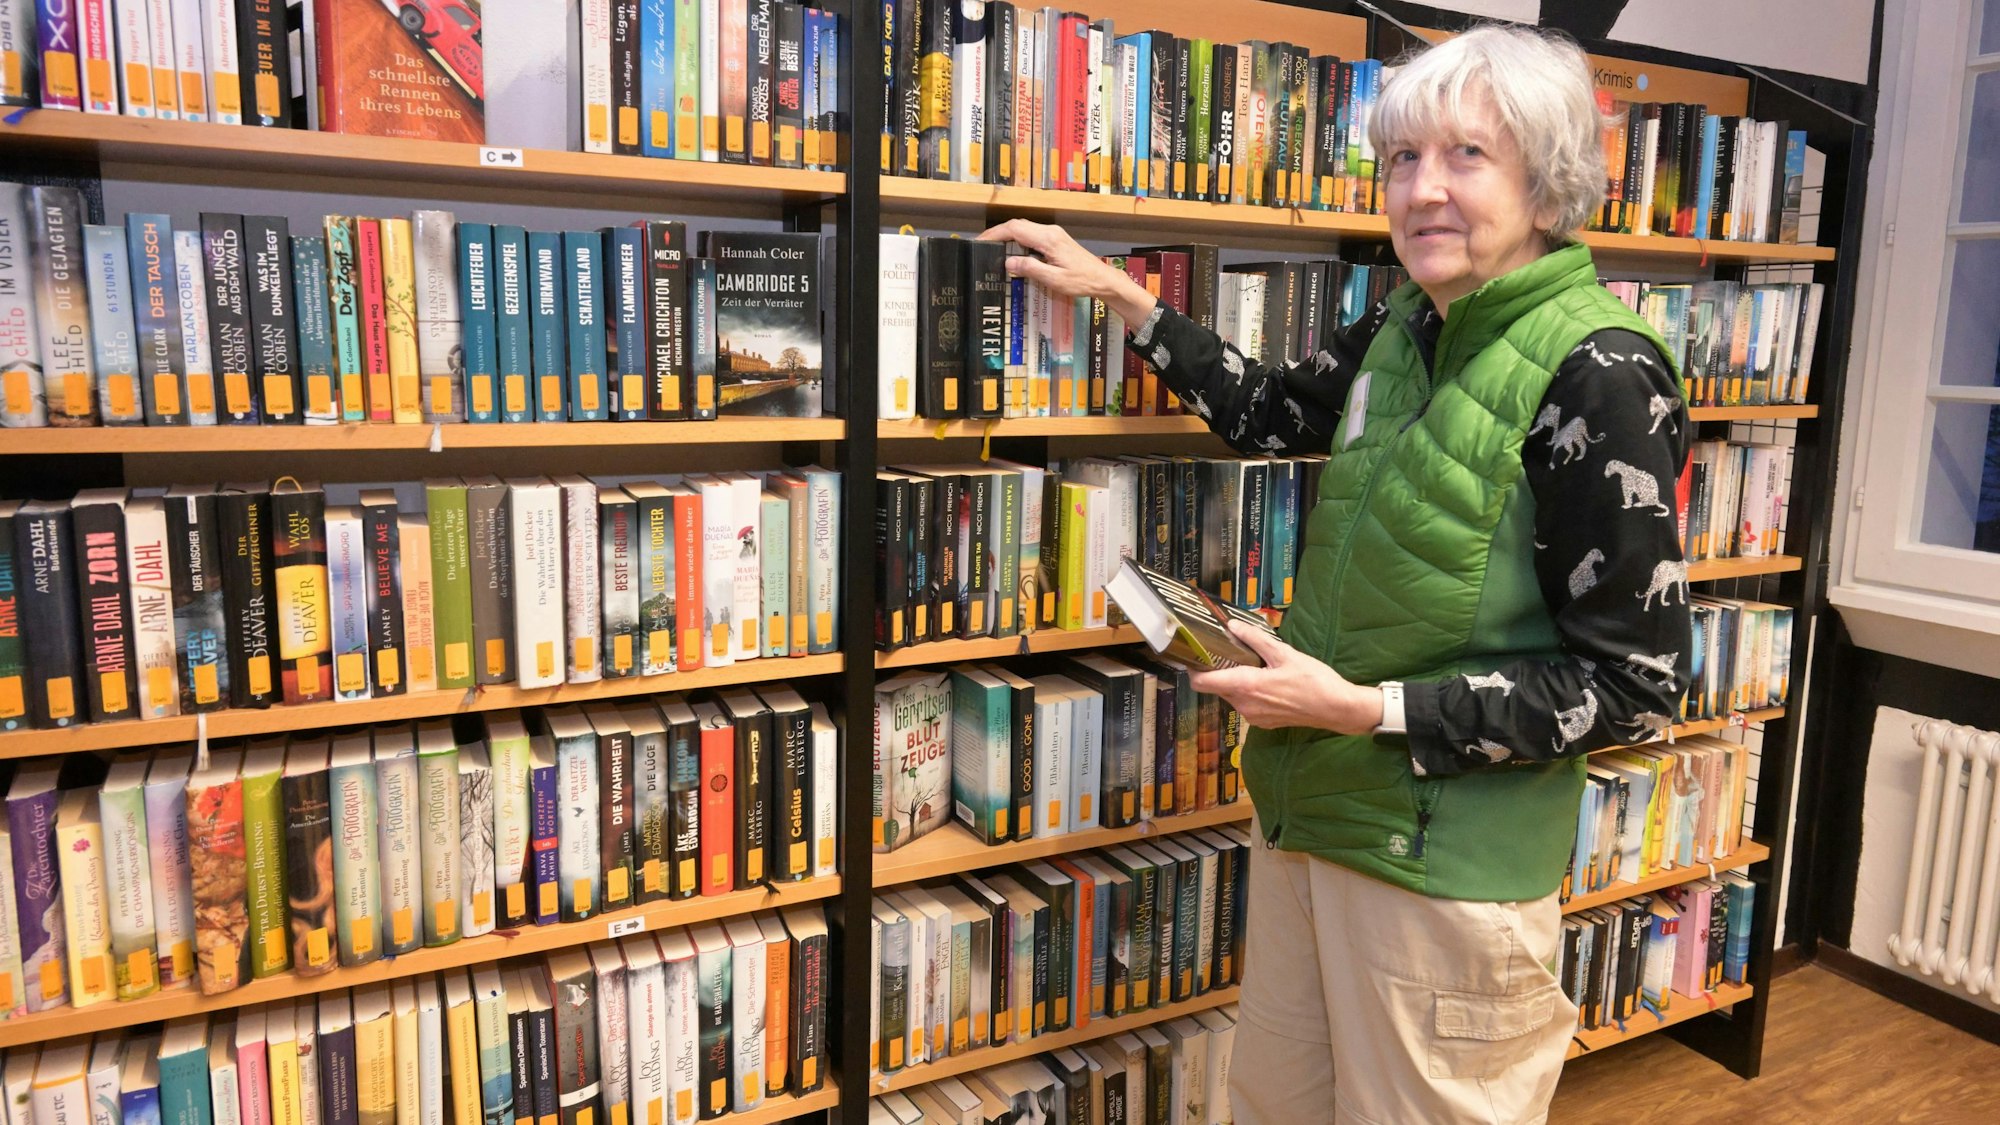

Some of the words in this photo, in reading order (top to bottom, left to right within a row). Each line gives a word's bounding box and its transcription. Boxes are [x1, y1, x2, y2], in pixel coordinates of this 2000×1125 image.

[615, 2, 625, 42] Lügen.
[885, 4, 893, 41] KIND
[1004, 10, 1010, 25] 23
[395, 54, 424, 68] Das
[787, 41, 798, 71] BESTIE
[1180, 49, 1188, 87] Schinder
[1239, 55, 1249, 87] Hand
[369, 68, 450, 87] schnellste
[381, 84, 440, 102] Rennen
[779, 82, 788, 106] CHRIS
[788, 78, 799, 110] CARTER
[1200, 65, 1210, 117] Herzschuss
[1223, 57, 1232, 107] EISENBERG
[1594, 68, 1633, 89] Krimis
[360, 98, 401, 114] ihres
[406, 103, 462, 119] Lebens
[1092, 104, 1100, 139] FITZEK
[1178, 92, 1186, 122] Unterm
[1239, 93, 1248, 119] Tote
[1220, 110, 1233, 165] FÖHR
[486, 152, 496, 162] C
[47, 206, 68, 280] GEJAGTEN
[144, 223, 162, 279] TAUSCH
[212, 238, 225, 282] JUNGE
[224, 229, 238, 266] WALD
[257, 253, 267, 261] IM
[266, 229, 277, 259] LIEGT
[655, 250, 680, 261] MICRO
[721, 247, 767, 259] Hannah
[771, 248, 804, 259] Coler
[103, 253, 116, 300] STUNDEN
[229, 268, 239, 293] DEM
[259, 262, 269, 292] WAS
[335, 250, 349, 285] Zopf
[469, 242, 486, 311] LEUCHTFEUER
[503, 243, 519, 315] GEZEITENSPIEL
[539, 249, 554, 315] STURMWAND
[621, 244, 635, 324] FLAMMENMEER
[717, 274, 795, 292] CAMBRIDGE
[801, 278, 809, 292] 5
[883, 270, 916, 280] FOLLETT
[58, 289, 72, 309] DIE
[148, 286, 165, 318] DER
[179, 264, 193, 309] COBEN
[217, 286, 227, 307] DER
[269, 259, 282, 317] DUNKELN
[339, 289, 352, 315] Der
[576, 247, 593, 325] SCHATTENLAND
[722, 298, 741, 307] Zeit
[745, 298, 760, 307] der
[764, 298, 804, 308] Verräter
[1287, 271, 1295, 307] FRENCH
[108, 304, 118, 313] 61
[231, 296, 242, 315] AUS
[655, 278, 670, 333] CRICHTON
[674, 307, 682, 334] PRESTON
[883, 318, 916, 327] FREIHEIT
[885, 301, 915, 310] KINDER
[1286, 308, 1295, 326] TANA
[181, 314, 198, 363] HARLAN
[346, 327, 354, 359] Colombani
[697, 317, 705, 354] DEBORAH
[982, 306, 1001, 357] NEVER
[261, 324, 275, 375] HARLAN
[274, 328, 287, 373] COBEN
[1254, 474, 1262, 535] GALBRAITH
[30, 520, 48, 558] DAHL
[289, 510, 299, 548] WAHL
[300, 517, 310, 540] LOS
[377, 523, 389, 543] ME
[477, 508, 485, 538] Dicker
[650, 508, 664, 552] TOCHTER
[51, 519, 60, 571] Bußestunde
[85, 532, 118, 585] ZORN
[189, 530, 200, 573] TÄUSCHER
[238, 535, 248, 556] DER
[248, 504, 262, 586] GIFTZEICHNER
[477, 540, 487, 559] Joel
[488, 508, 498, 575] Verschwinden
[36, 560, 49, 593] ARNE
[134, 540, 164, 583] DAHL
[377, 548, 390, 597] BELIEVE
[499, 541, 508, 585] Stephanie
[651, 555, 665, 592] LIEBSTE
[686, 546, 694, 573] wieder
[193, 574, 203, 591] DER
[489, 576, 498, 589] Das
[91, 593, 123, 631] DAHL
[138, 592, 168, 633] ARNE
[301, 577, 317, 643] DEAVER
[95, 634, 126, 672] ARNE
[895, 690, 952, 732] Gerritsen
[903, 692, 915, 705] Tess
[907, 721, 941, 750] BLUT
[1024, 713, 1032, 745] GONE
[647, 744, 655, 771] LÜGE
[750, 730, 760, 785] HELIX
[786, 730, 795, 768] MARC
[901, 739, 946, 773] ZEUGE
[1028, 748, 1032, 756] AS
[1050, 731, 1058, 786] Elbleuchten
[612, 739, 622, 803] WAHRHEIT
[647, 772, 656, 791] DIE
[1023, 758, 1032, 791] GOOD
[613, 804, 623, 825] DIE
[688, 791, 698, 850] EDWARDSON
[791, 788, 802, 837] Celsius
[675, 832, 689, 852] ÅKE
[1220, 881, 1232, 937] GRISHAM
[614, 925, 621, 934] E
[748, 957, 756, 999] Schwester
[748, 1000, 756, 1014] Die
[519, 1051, 527, 1089] Spanische
[651, 1040, 662, 1093] FIELDING
